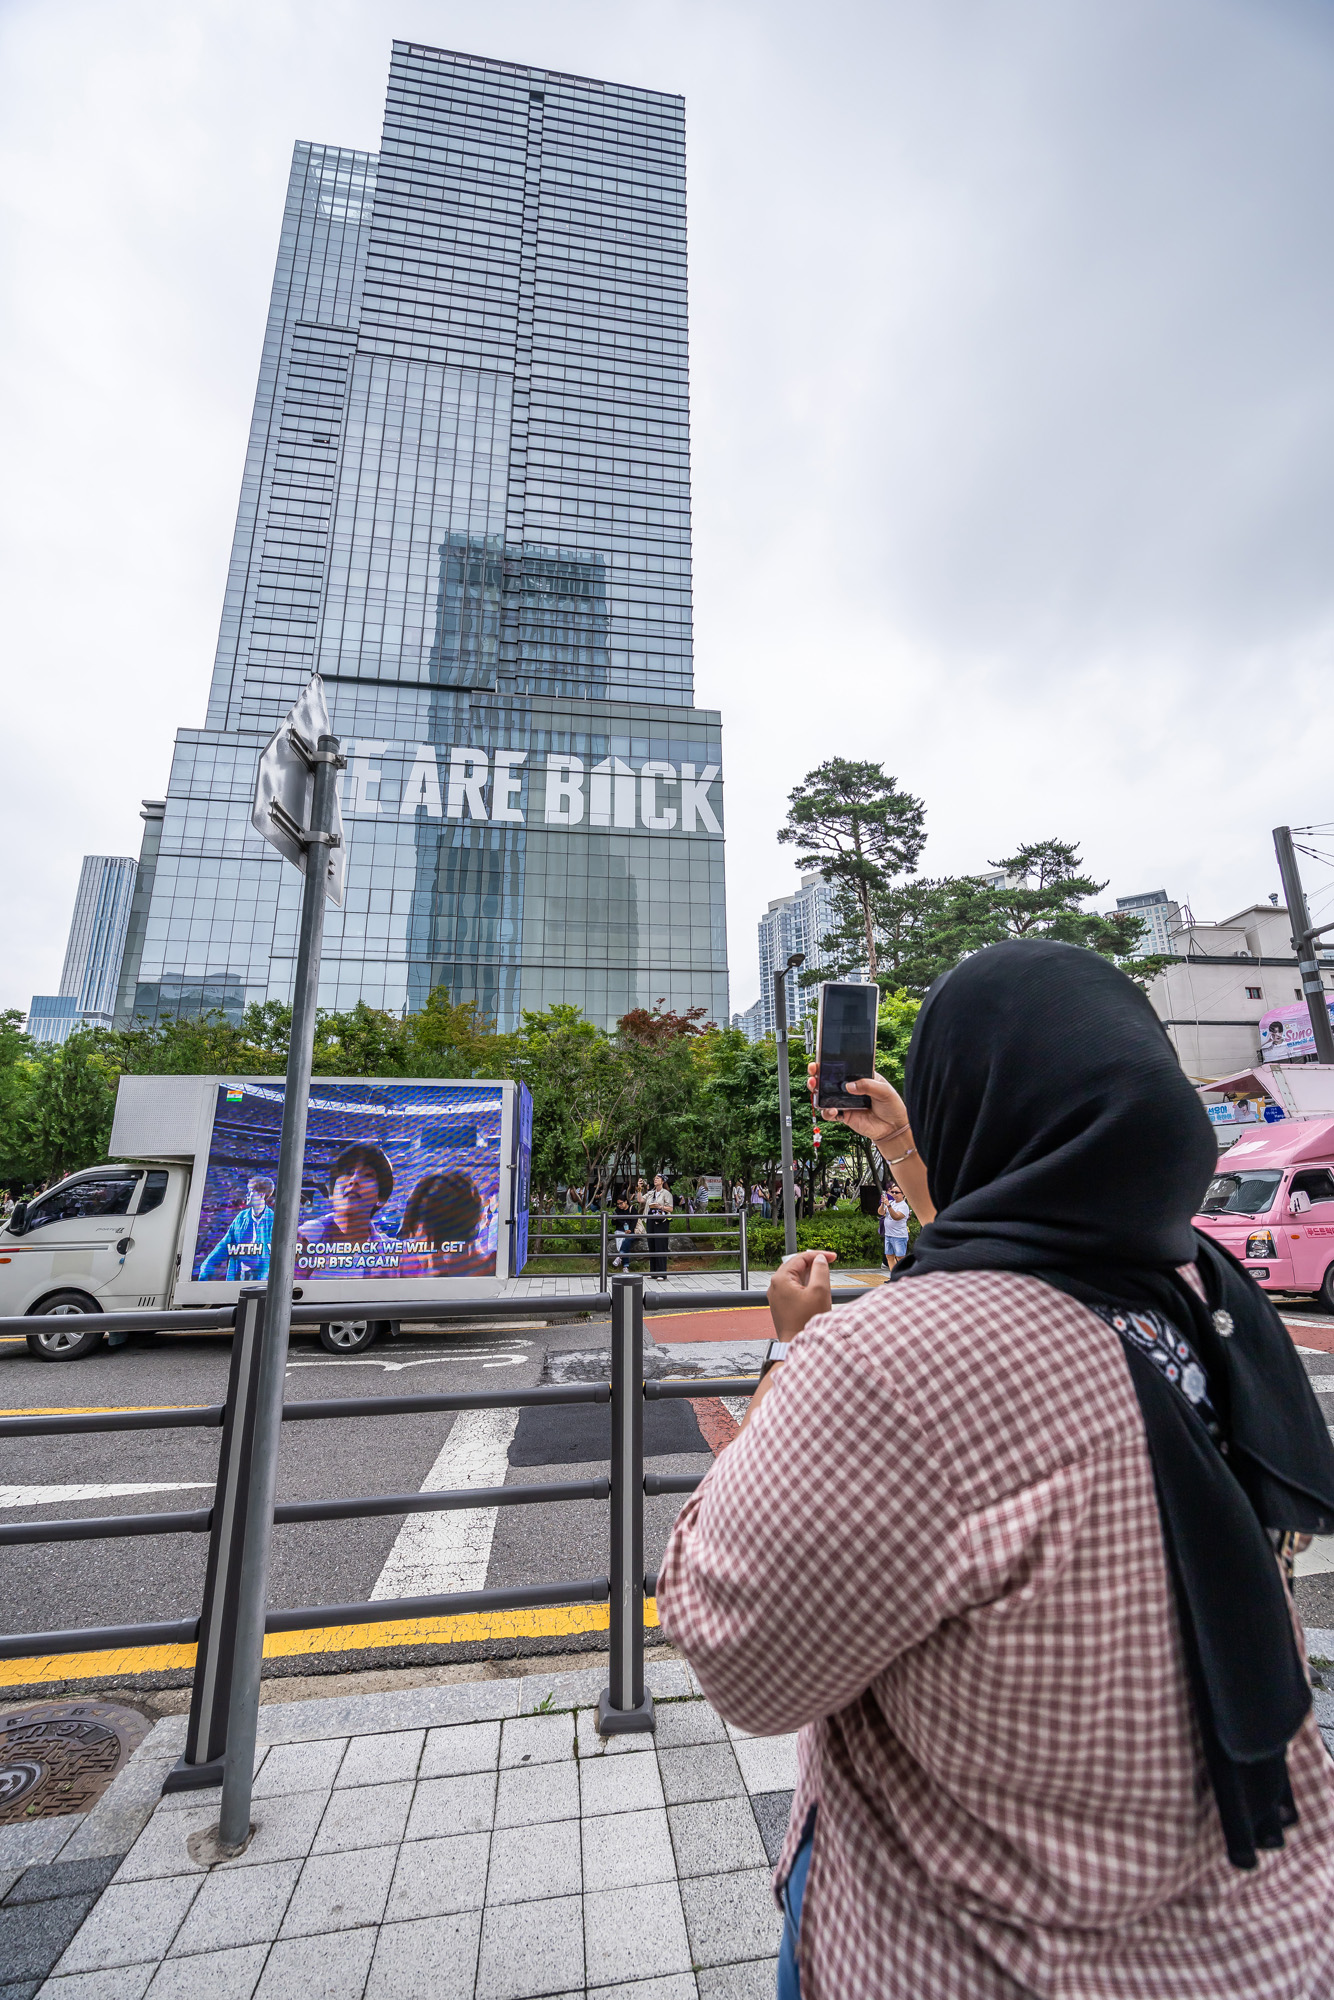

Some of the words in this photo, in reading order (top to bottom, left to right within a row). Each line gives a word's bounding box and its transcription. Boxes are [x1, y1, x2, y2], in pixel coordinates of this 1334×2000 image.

[399, 745, 528, 822] ARE
[1306, 1227, 1334, 1236] 푸드트럭
[227, 1243, 263, 1255] WITH
[306, 1242, 379, 1254] COMEBACK
[383, 1242, 402, 1254] WE
[407, 1241, 437, 1253] WILL
[441, 1241, 466, 1252] GET
[298, 1256, 325, 1268] OUR
[329, 1256, 353, 1268] BTS
[356, 1255, 399, 1267] AGAIN
